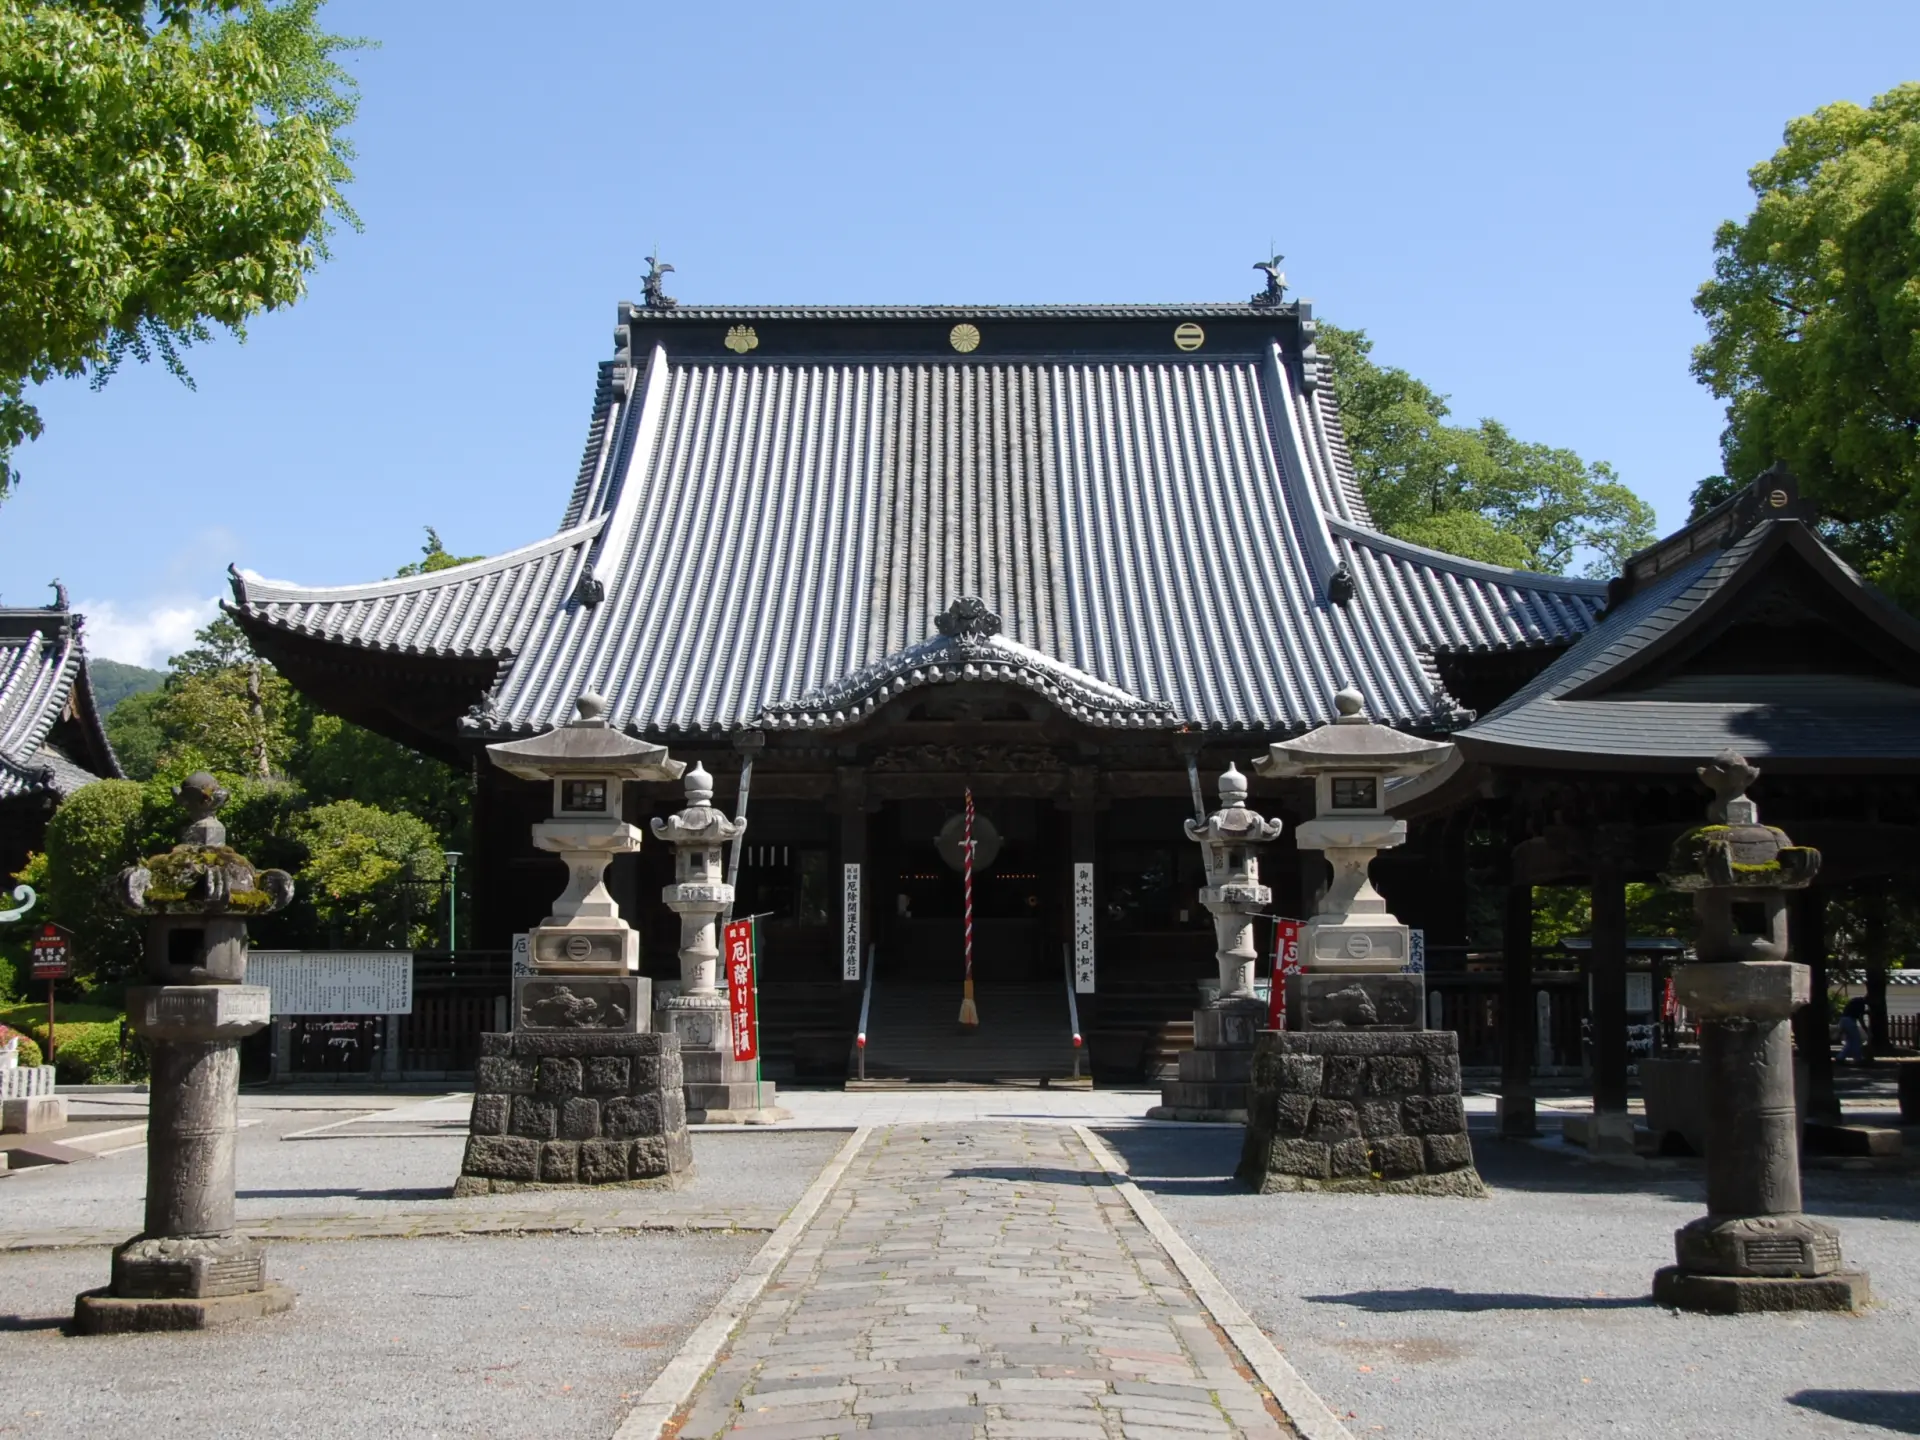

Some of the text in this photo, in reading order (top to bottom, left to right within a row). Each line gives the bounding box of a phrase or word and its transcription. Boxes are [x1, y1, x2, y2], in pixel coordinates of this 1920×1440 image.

[731, 940, 751, 1052] 厄除け祈願
